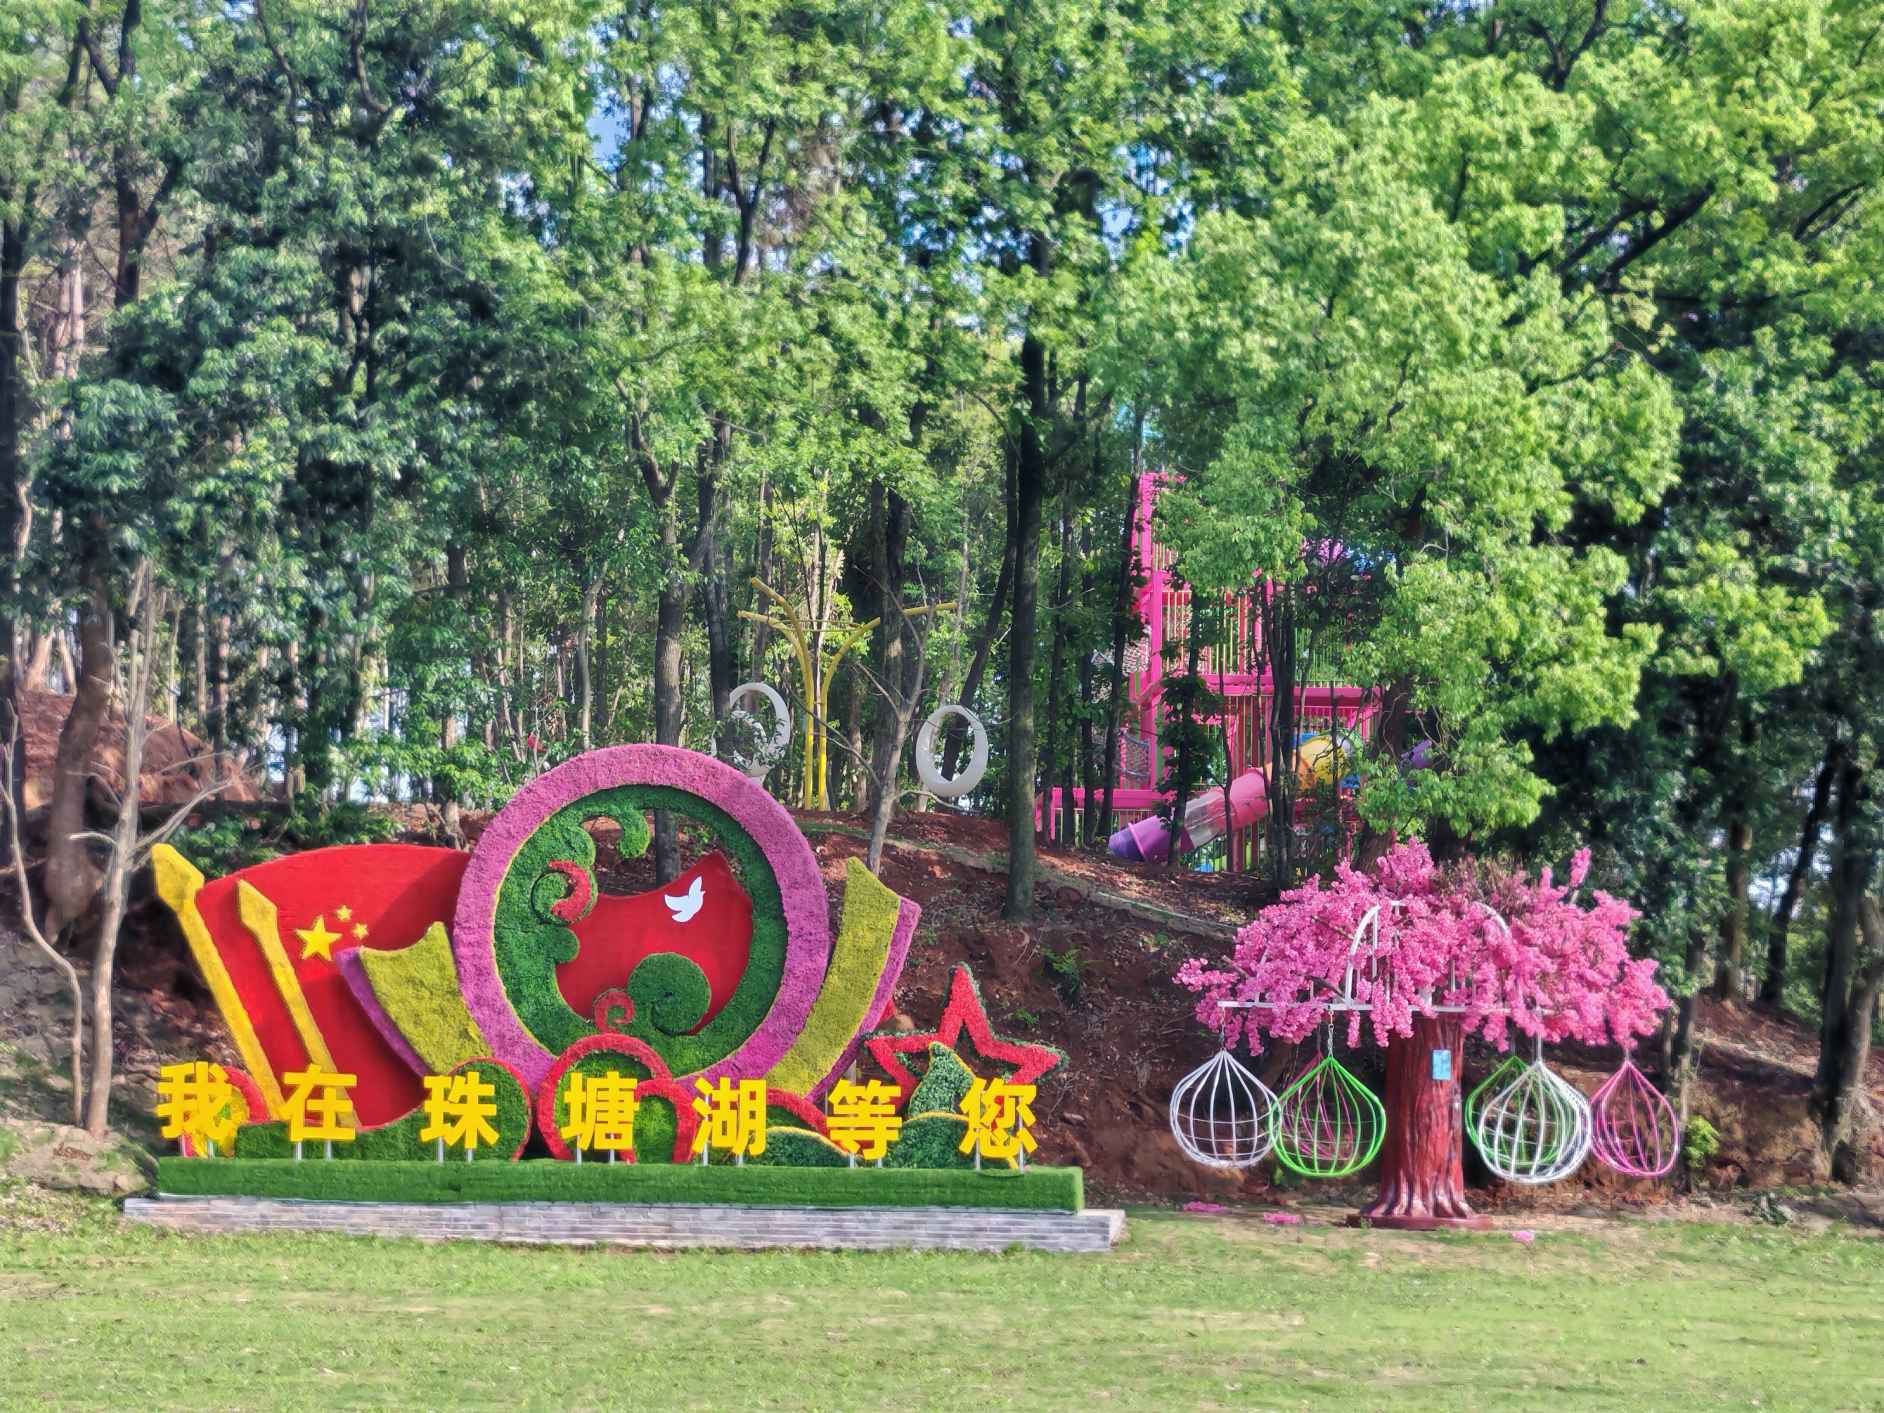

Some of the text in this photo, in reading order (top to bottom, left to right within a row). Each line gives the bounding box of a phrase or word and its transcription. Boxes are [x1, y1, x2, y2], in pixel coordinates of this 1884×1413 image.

[157, 1061, 1038, 1160] 我在珠塘湖等您
